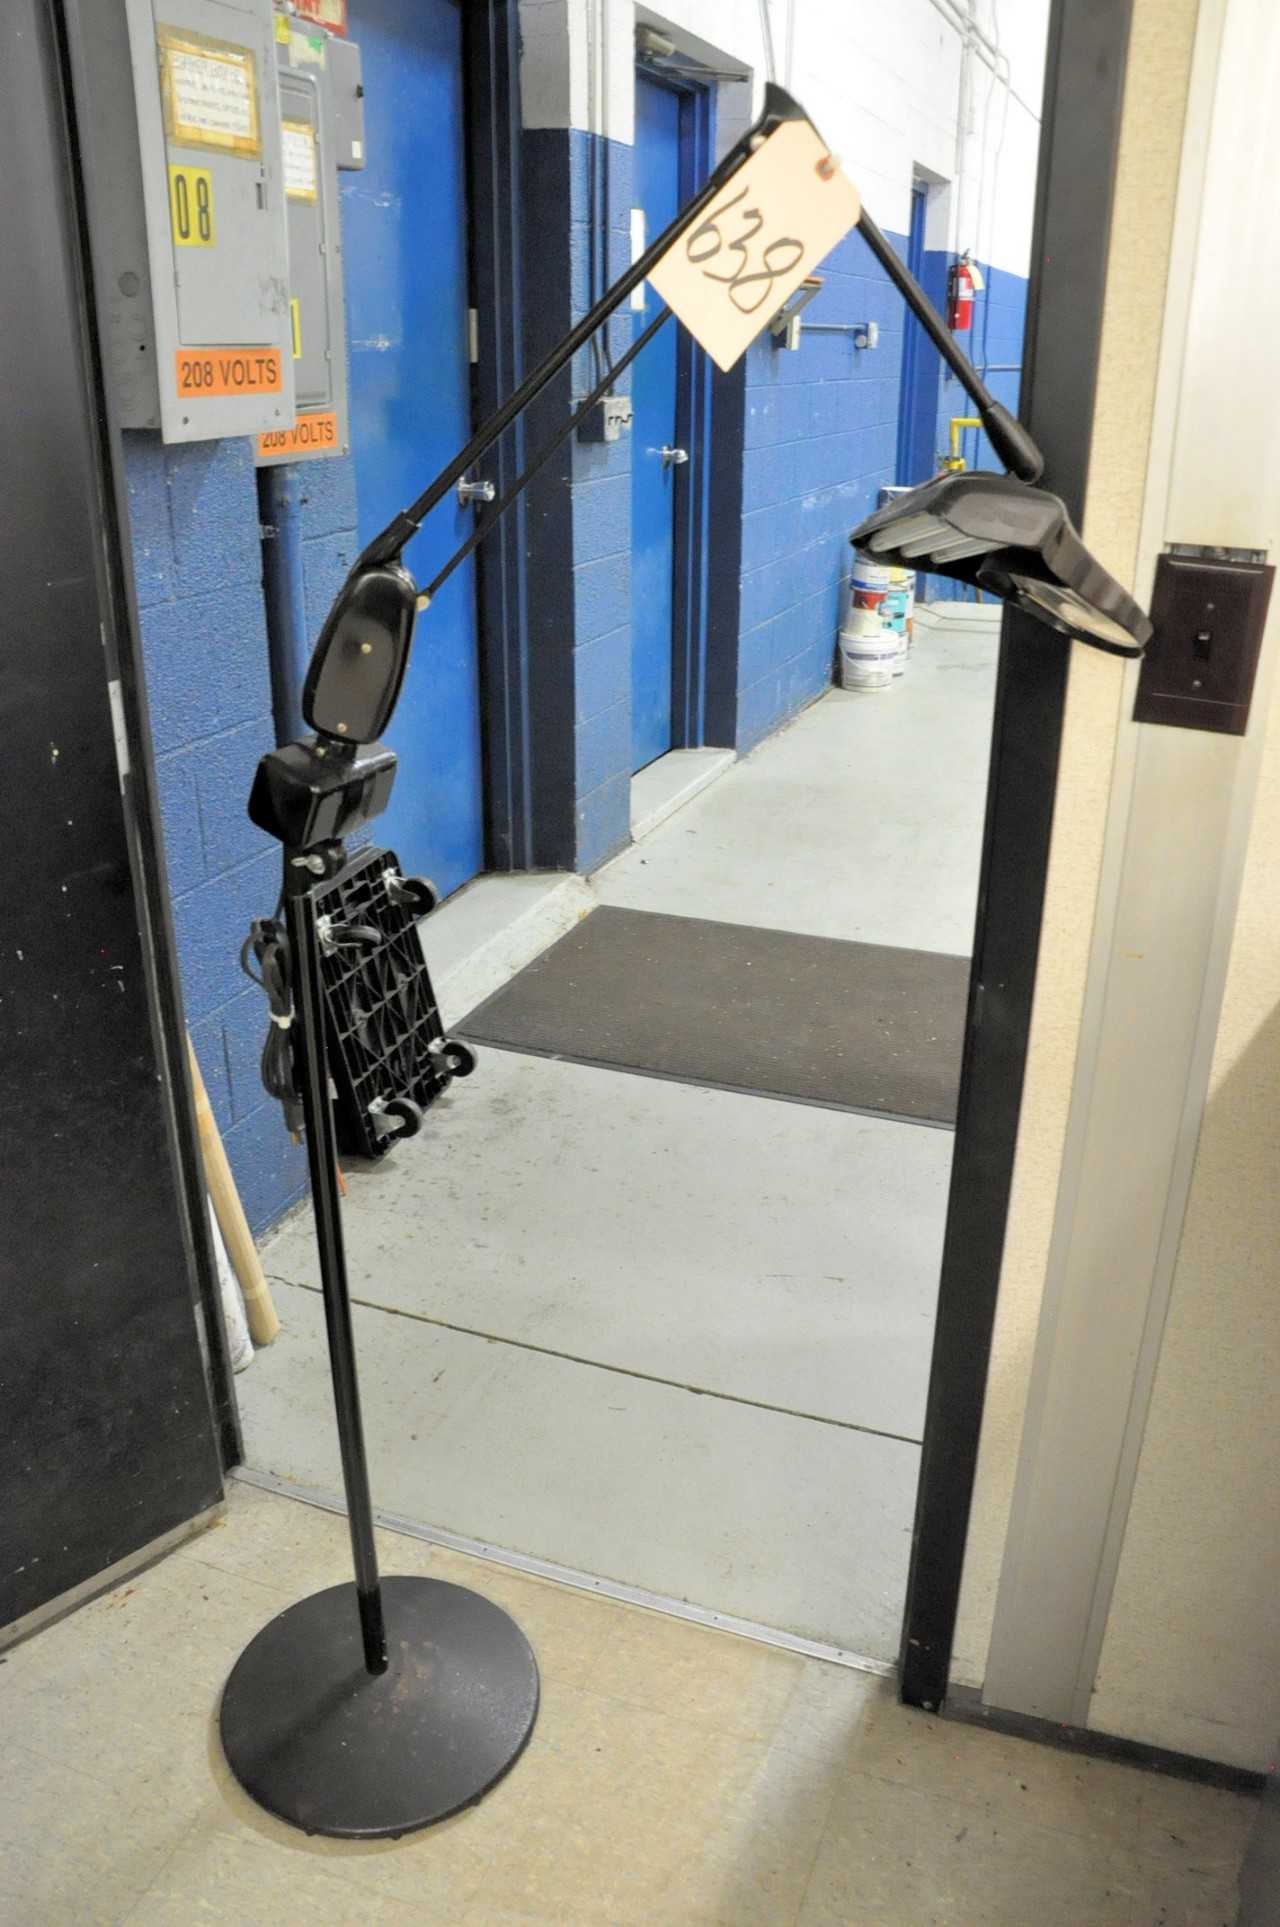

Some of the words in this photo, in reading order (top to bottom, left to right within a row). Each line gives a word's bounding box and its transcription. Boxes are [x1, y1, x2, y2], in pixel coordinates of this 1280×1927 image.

[174, 174, 211, 242] 08
[686, 185, 804, 314] 638
[182, 361, 213, 388] 208
[219, 358, 276, 386] VOLTS
[291, 421, 333, 444] VOLTS
